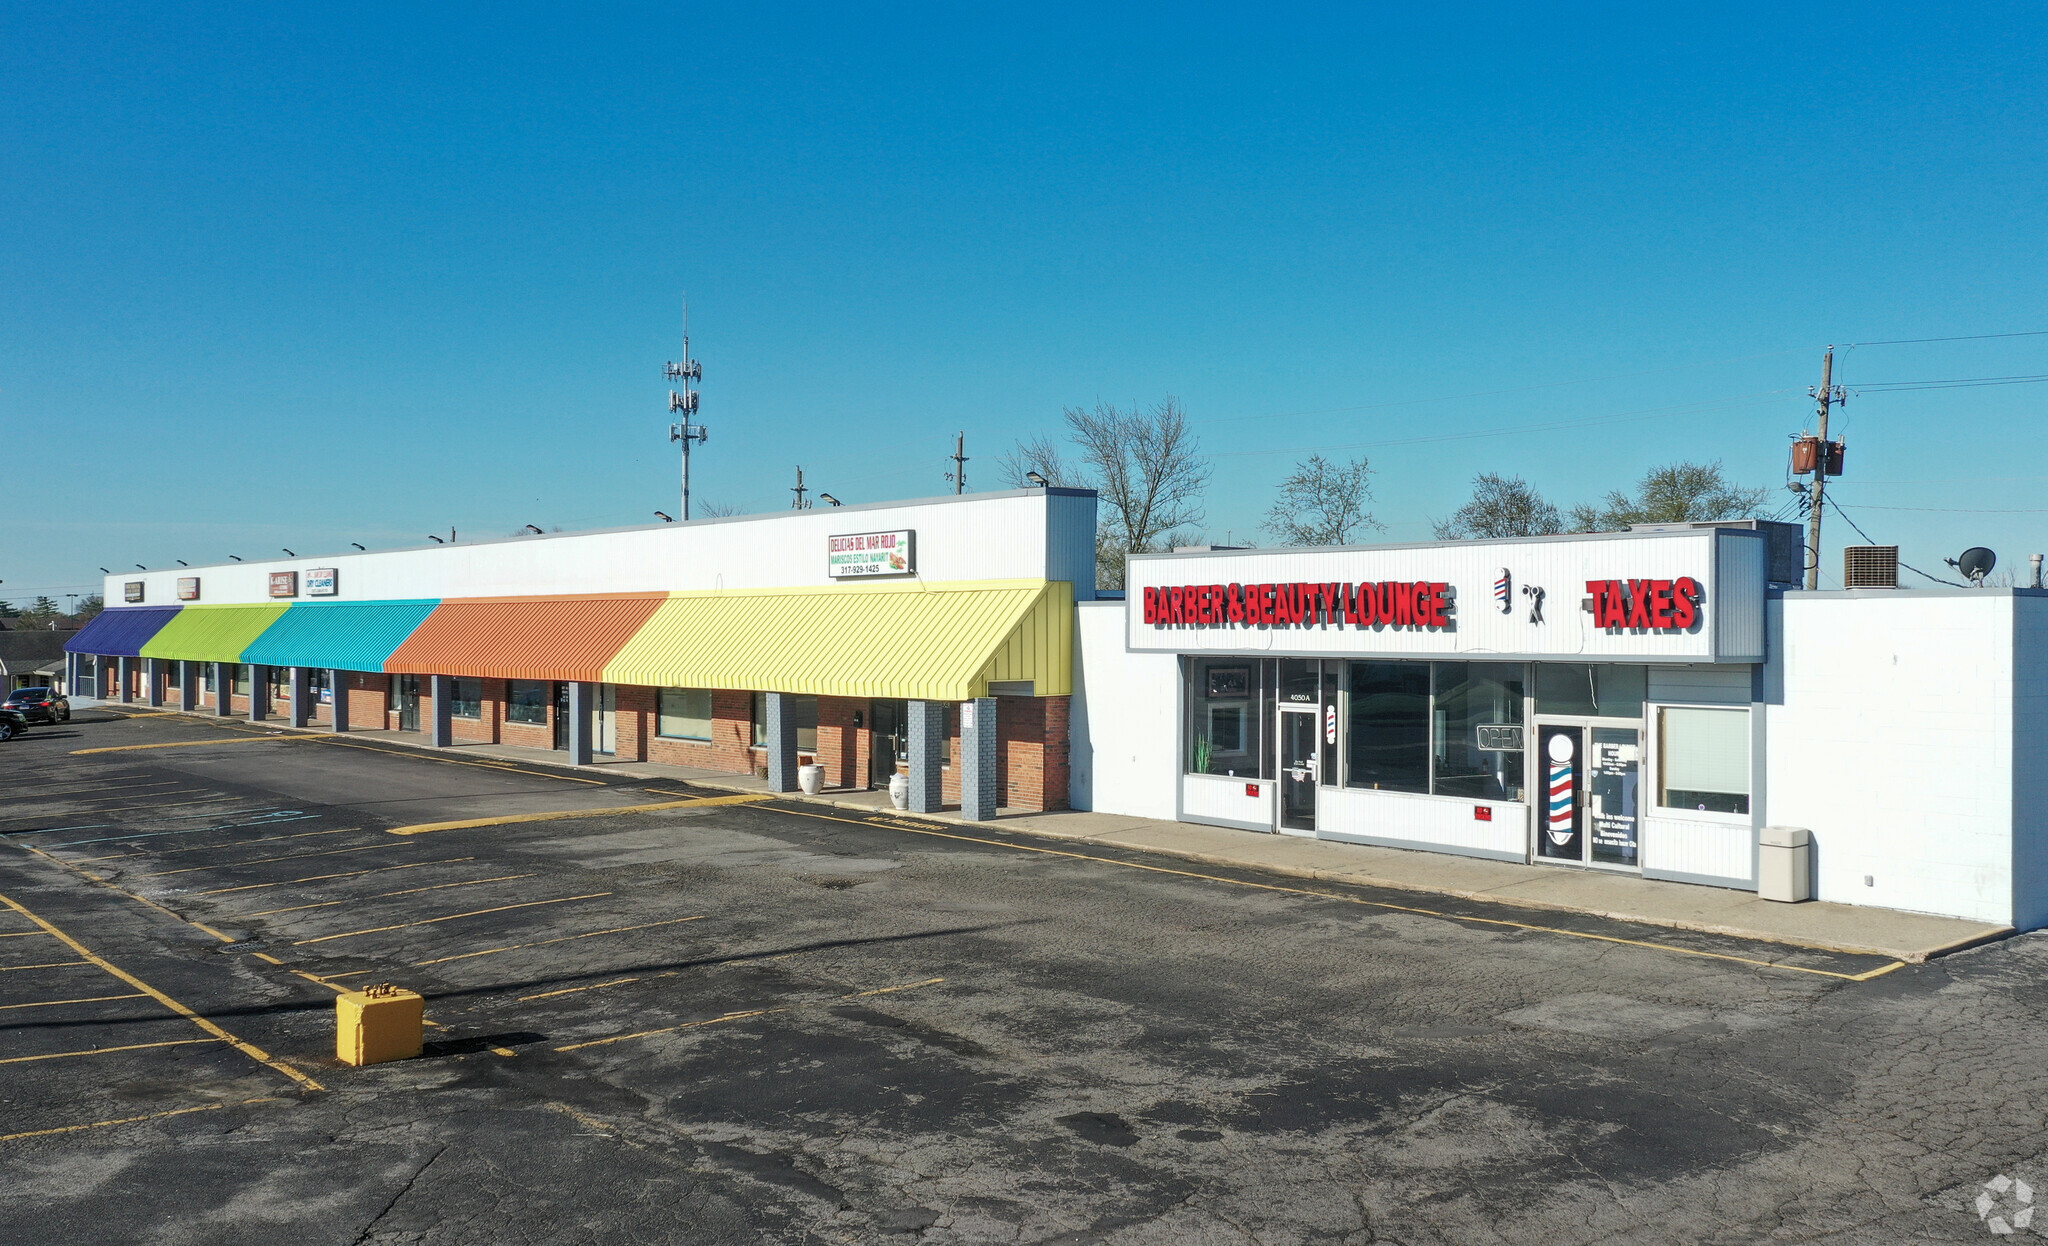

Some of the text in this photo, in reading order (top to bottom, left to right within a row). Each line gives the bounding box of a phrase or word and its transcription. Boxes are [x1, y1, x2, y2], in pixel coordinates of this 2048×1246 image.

[830, 535, 896, 552] DELICIAS DEL MAR ROJO
[830, 552, 889, 565] MARISCOS ESTILO NAYARIT
[841, 564, 880, 574] 317-929-1425
[1343, 580, 1450, 627] LOUNGE
[1585, 576, 1698, 629] TAXES
[1479, 728, 1524, 749] OPEN
